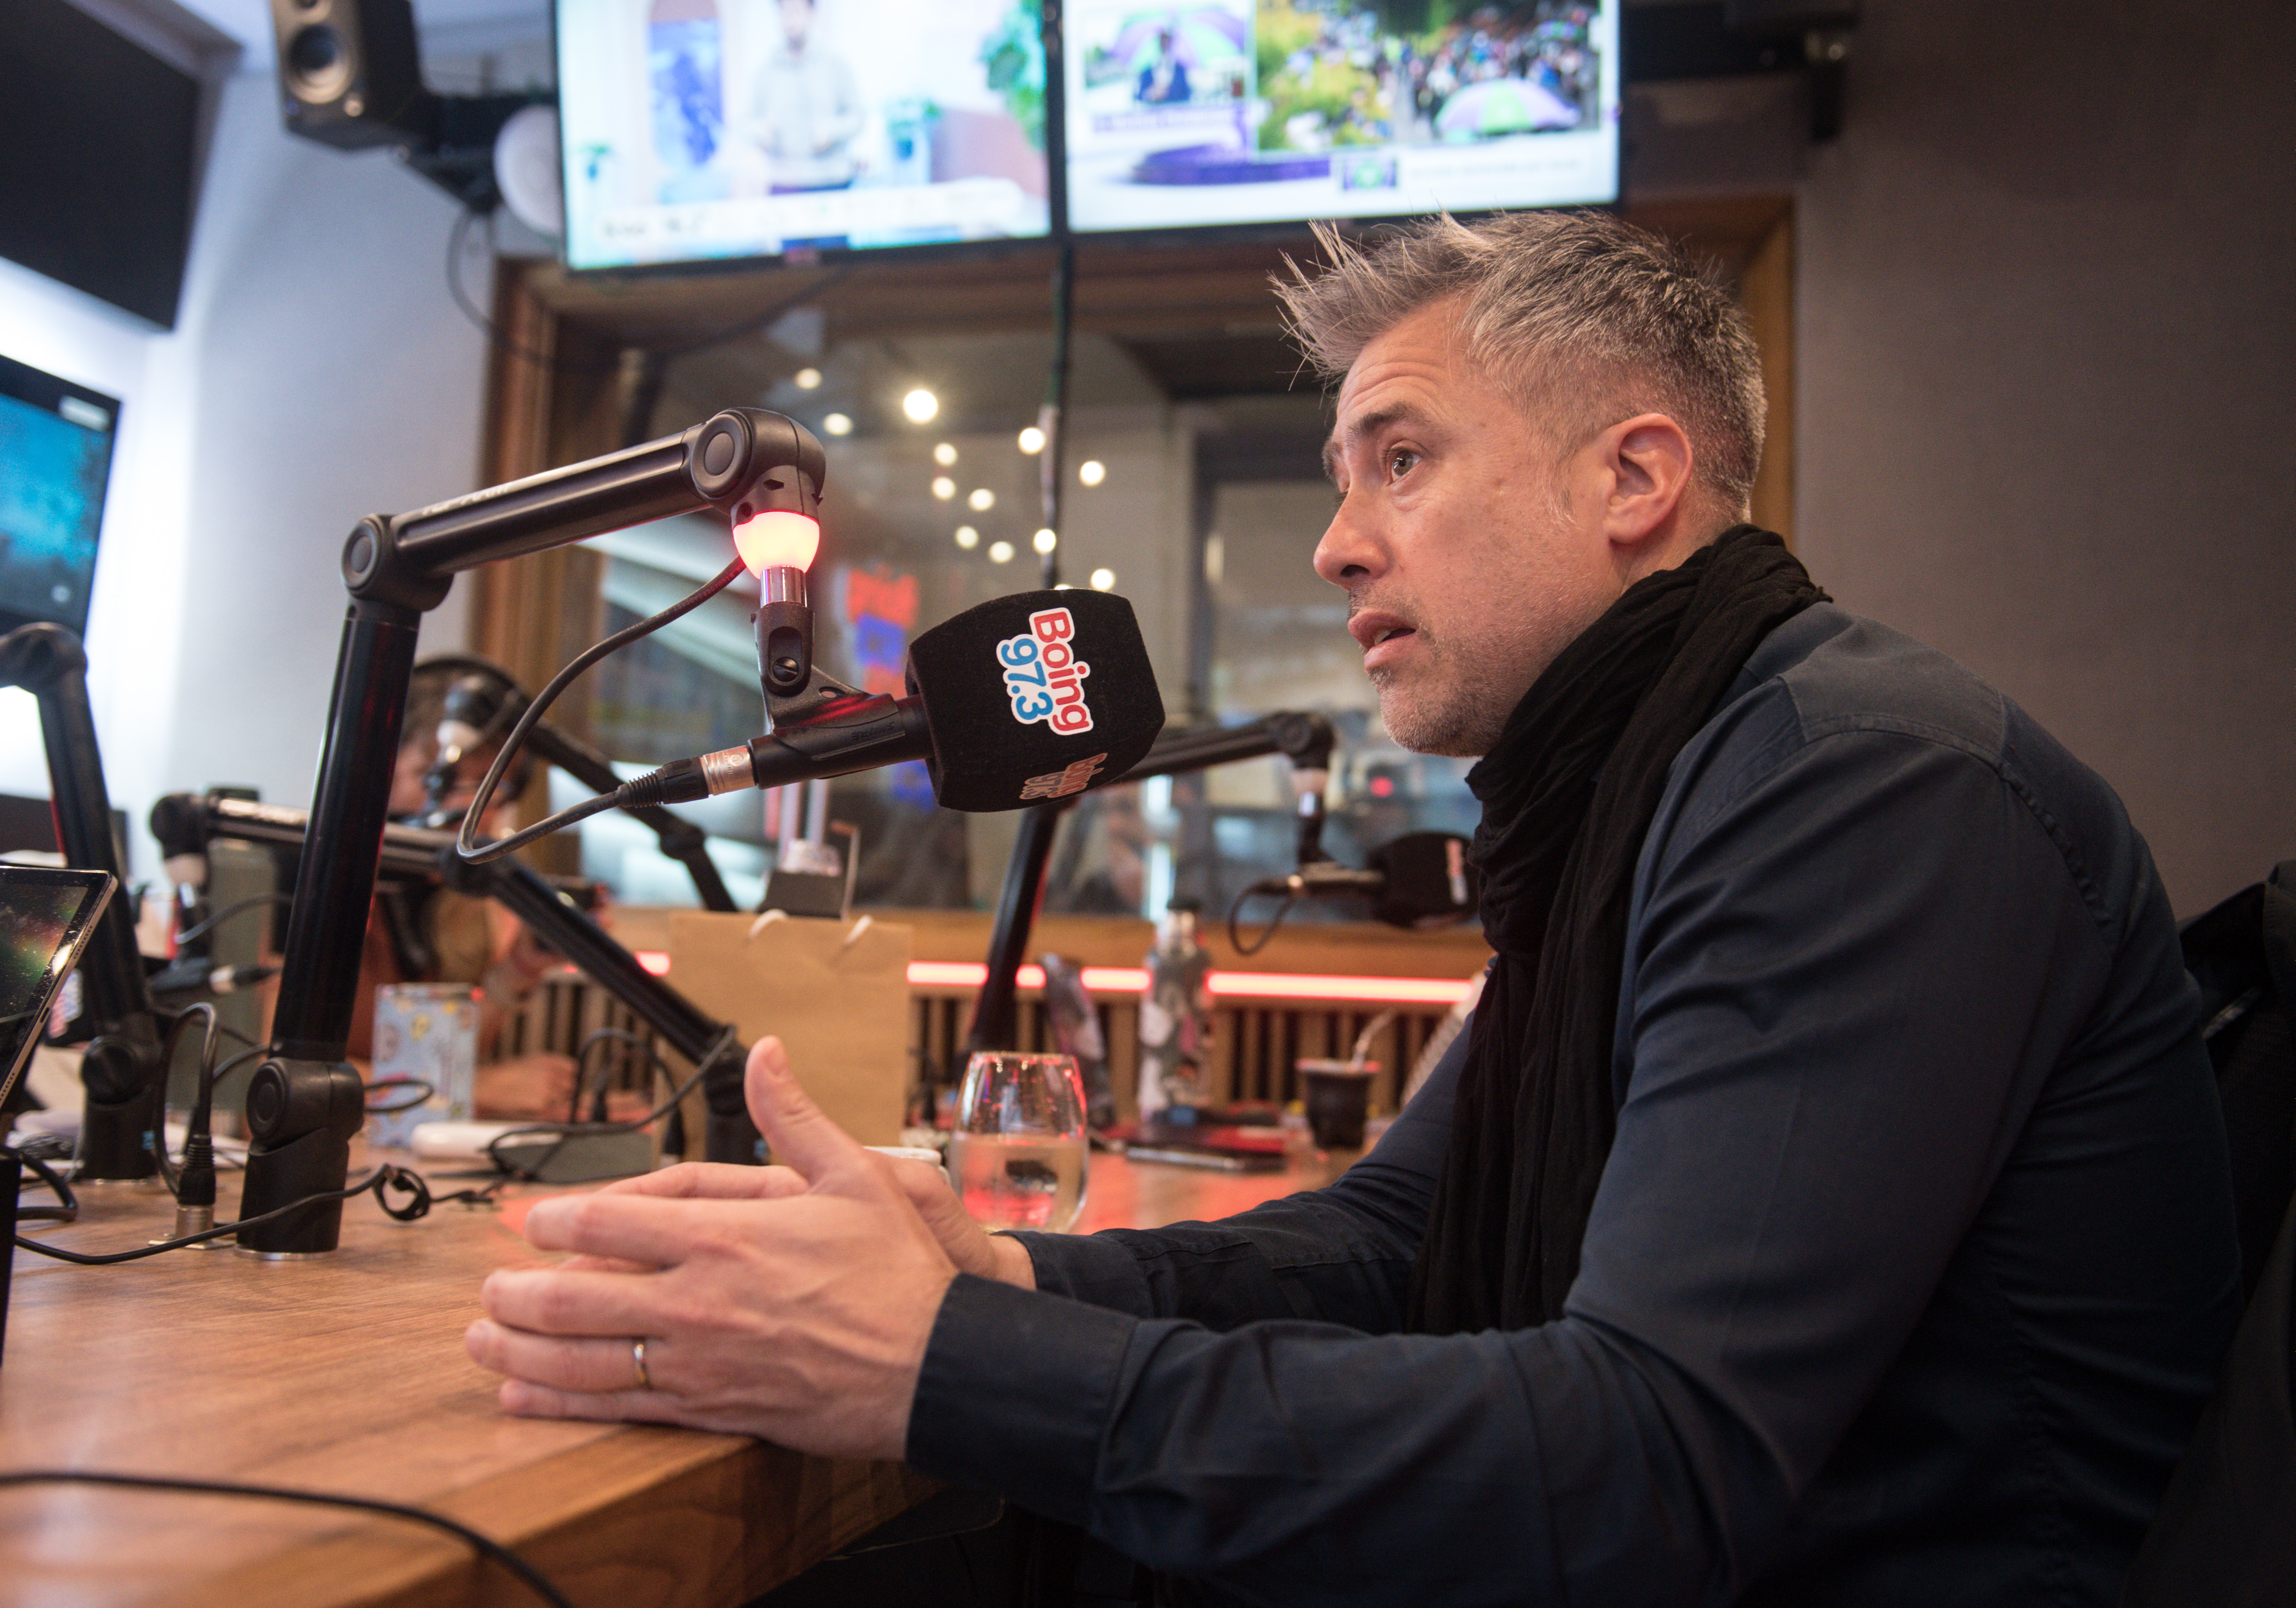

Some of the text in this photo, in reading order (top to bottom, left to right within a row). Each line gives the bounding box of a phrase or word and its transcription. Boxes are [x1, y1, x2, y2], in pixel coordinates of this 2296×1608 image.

[1001, 638, 1053, 720] 97.3
[1033, 611, 1090, 732] Boing
[1023, 773, 1065, 798] 97.3
